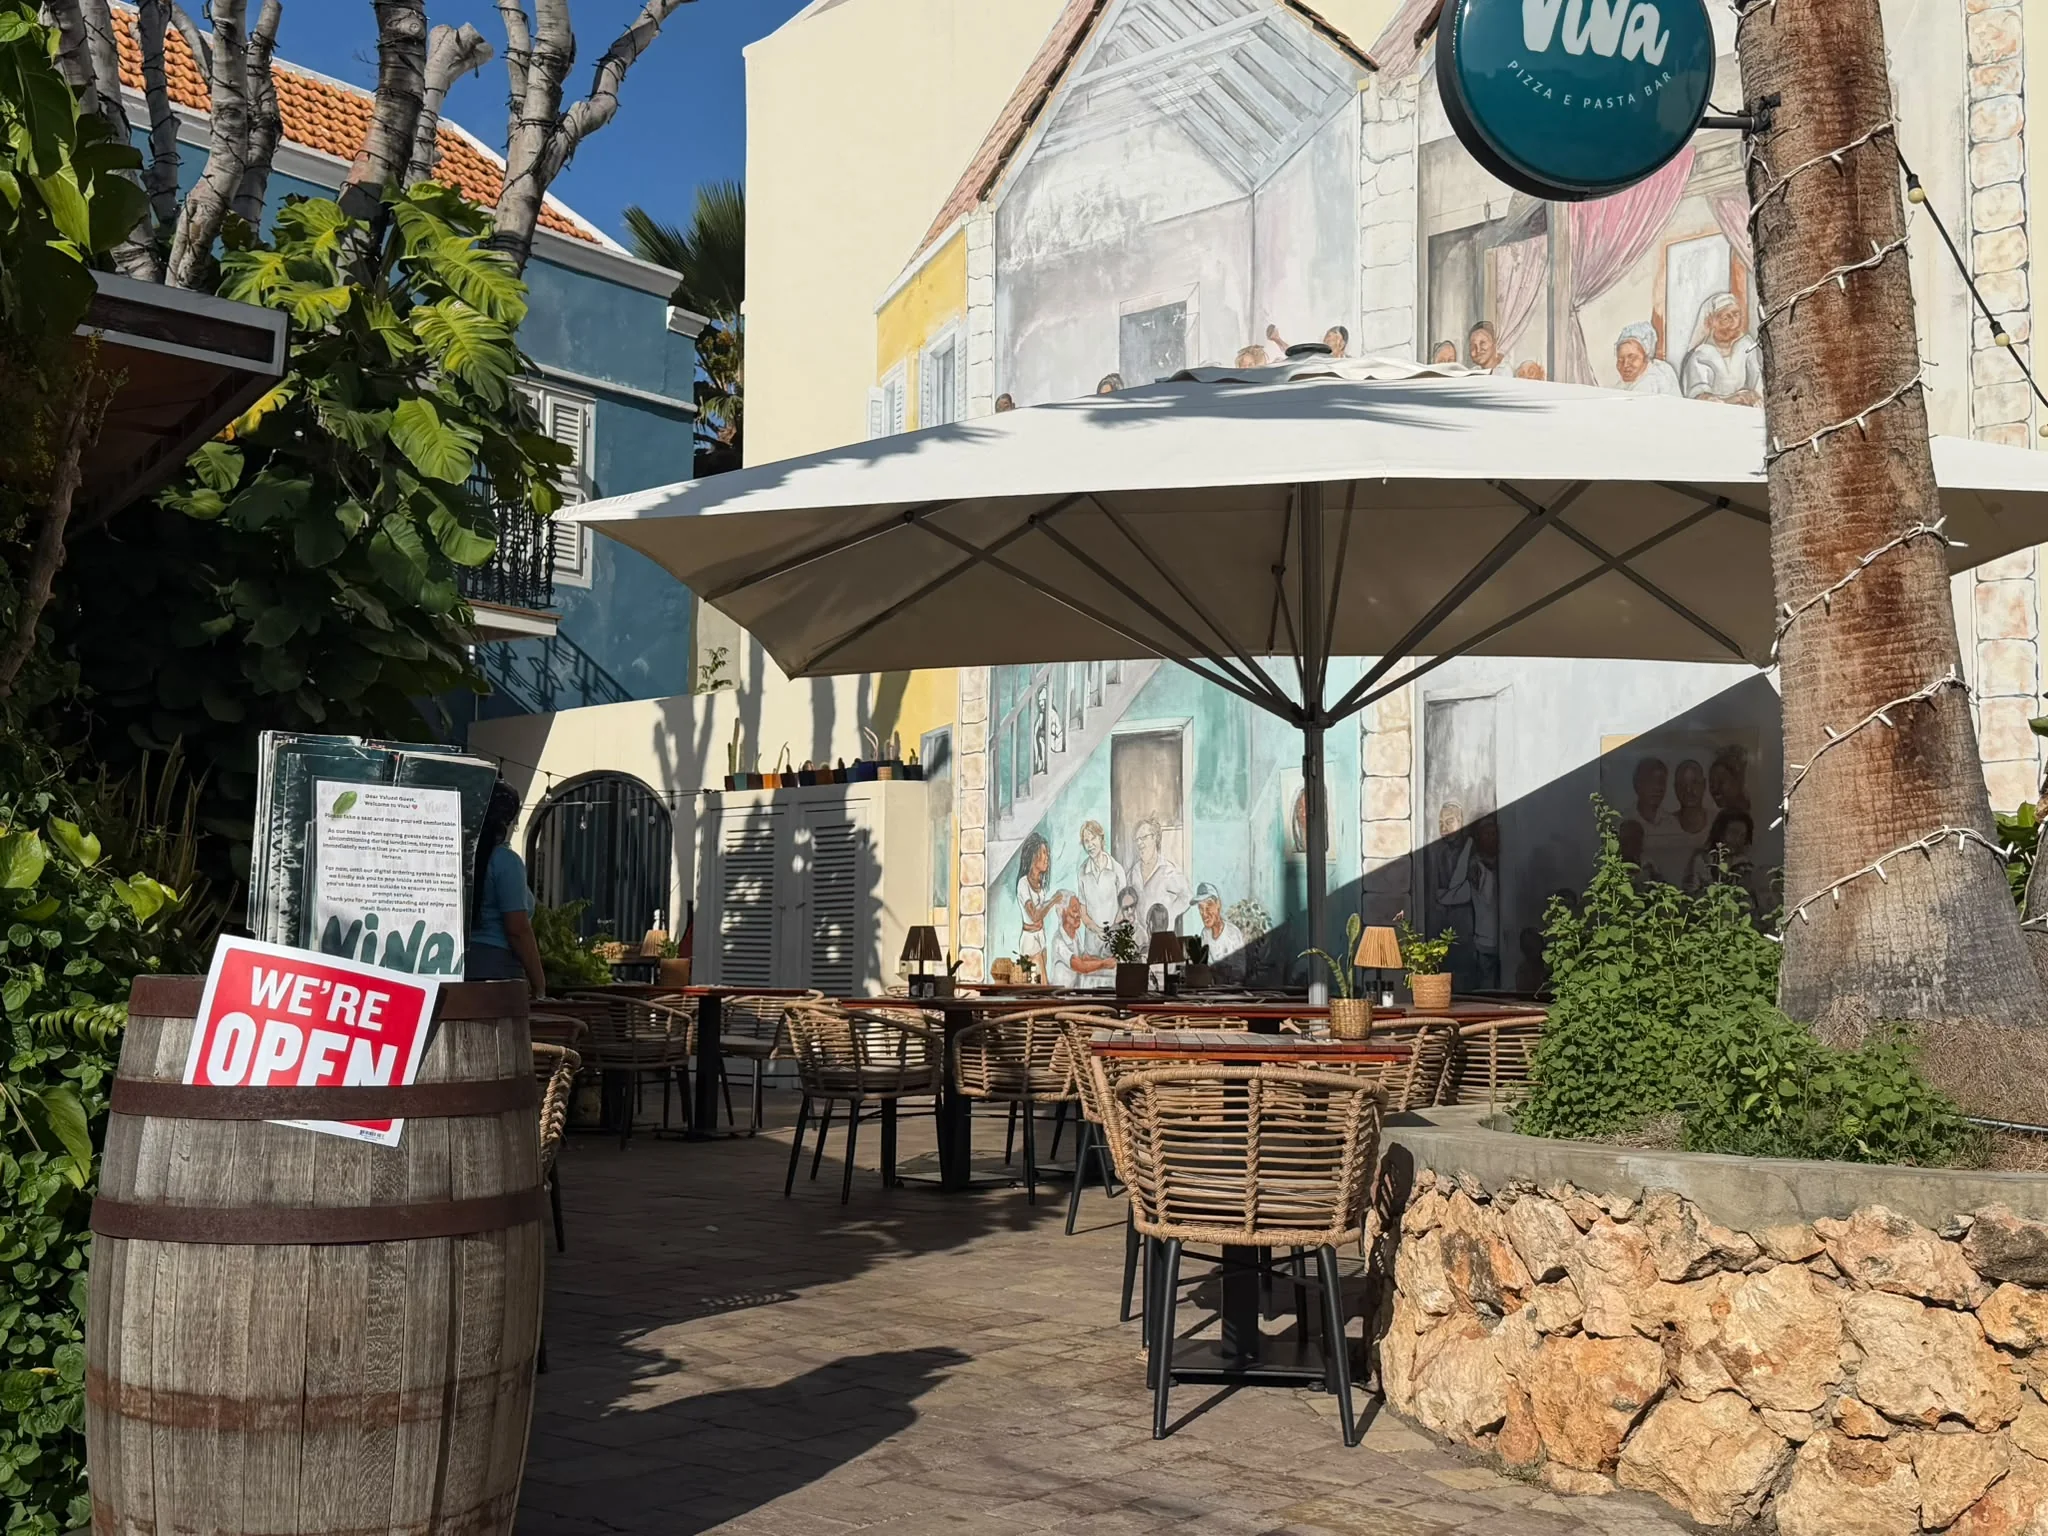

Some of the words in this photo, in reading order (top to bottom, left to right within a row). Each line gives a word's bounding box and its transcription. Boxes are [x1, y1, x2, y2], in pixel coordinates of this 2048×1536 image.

[1507, 60, 1553, 100] PIZZA
[1563, 94, 1573, 106] E
[1583, 93, 1637, 109] PASTA
[1644, 71, 1672, 97] BAR
[250, 966, 390, 1032] WE'RE
